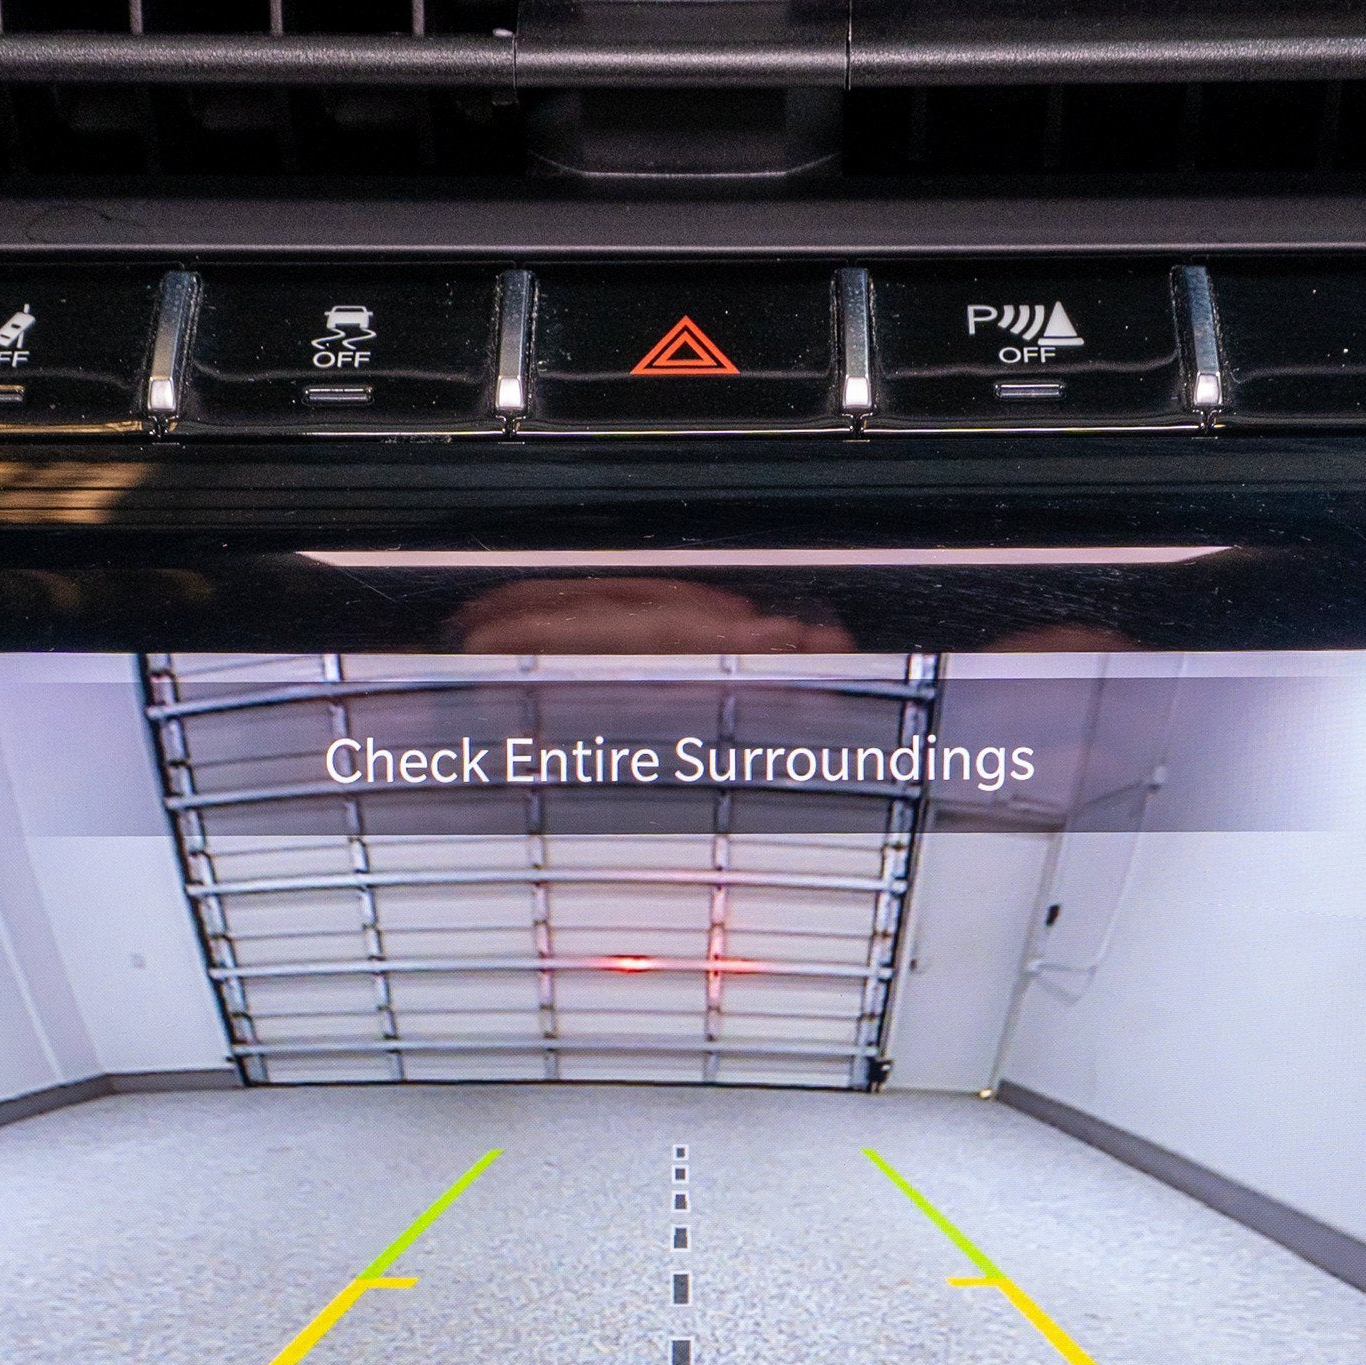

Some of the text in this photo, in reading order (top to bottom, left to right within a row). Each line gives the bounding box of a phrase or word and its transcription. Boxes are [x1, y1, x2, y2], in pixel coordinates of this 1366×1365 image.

[312, 351, 371, 368] OFF
[998, 346, 1056, 363] OFF
[325, 734, 1035, 792] Check Entire Surroundings
